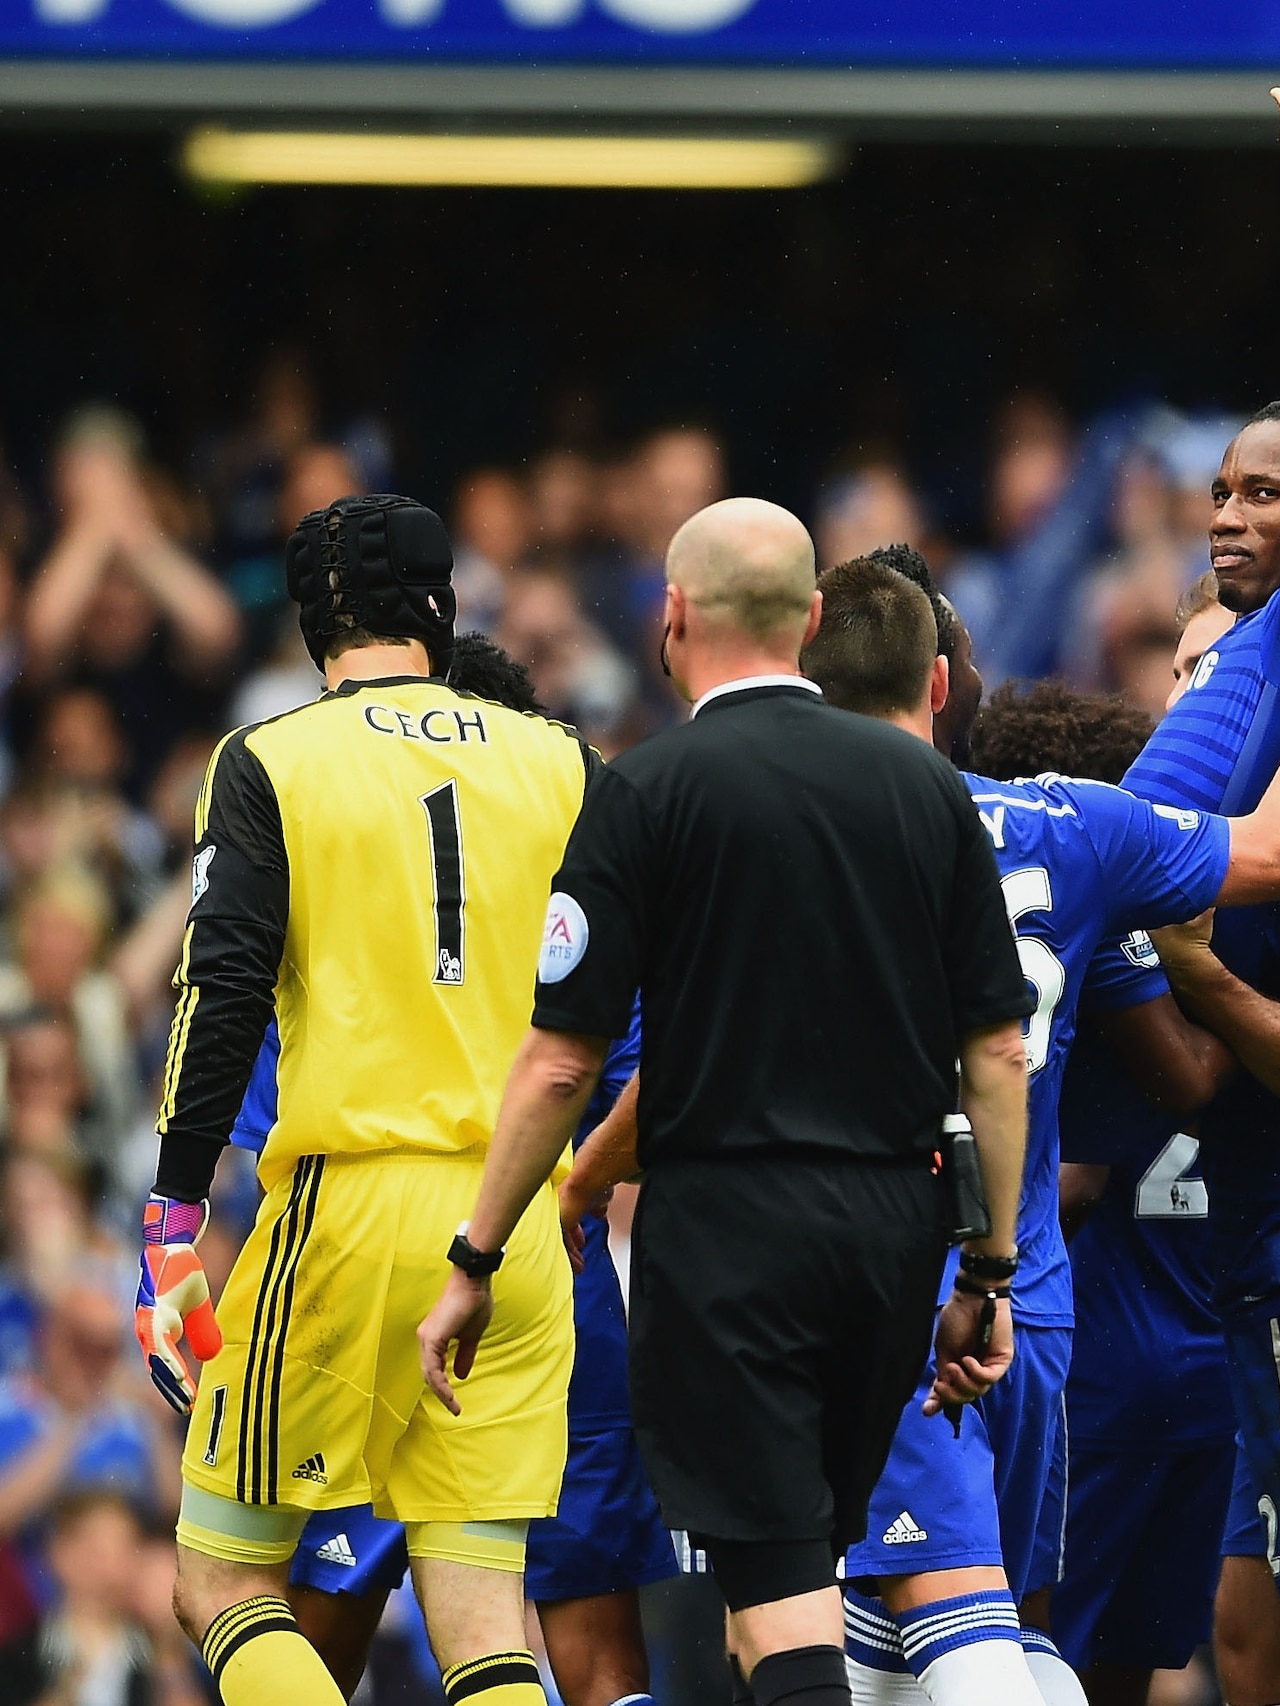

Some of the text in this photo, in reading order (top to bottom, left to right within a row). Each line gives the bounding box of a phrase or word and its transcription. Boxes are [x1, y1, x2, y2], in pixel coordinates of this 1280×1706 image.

[365, 705, 487, 743] CECH
[418, 778, 465, 986] 1
[201, 1384, 228, 1467] 1
[292, 1469, 328, 1485] adidas
[882, 1530, 928, 1545] adidas
[316, 1549, 358, 1567] adidas
